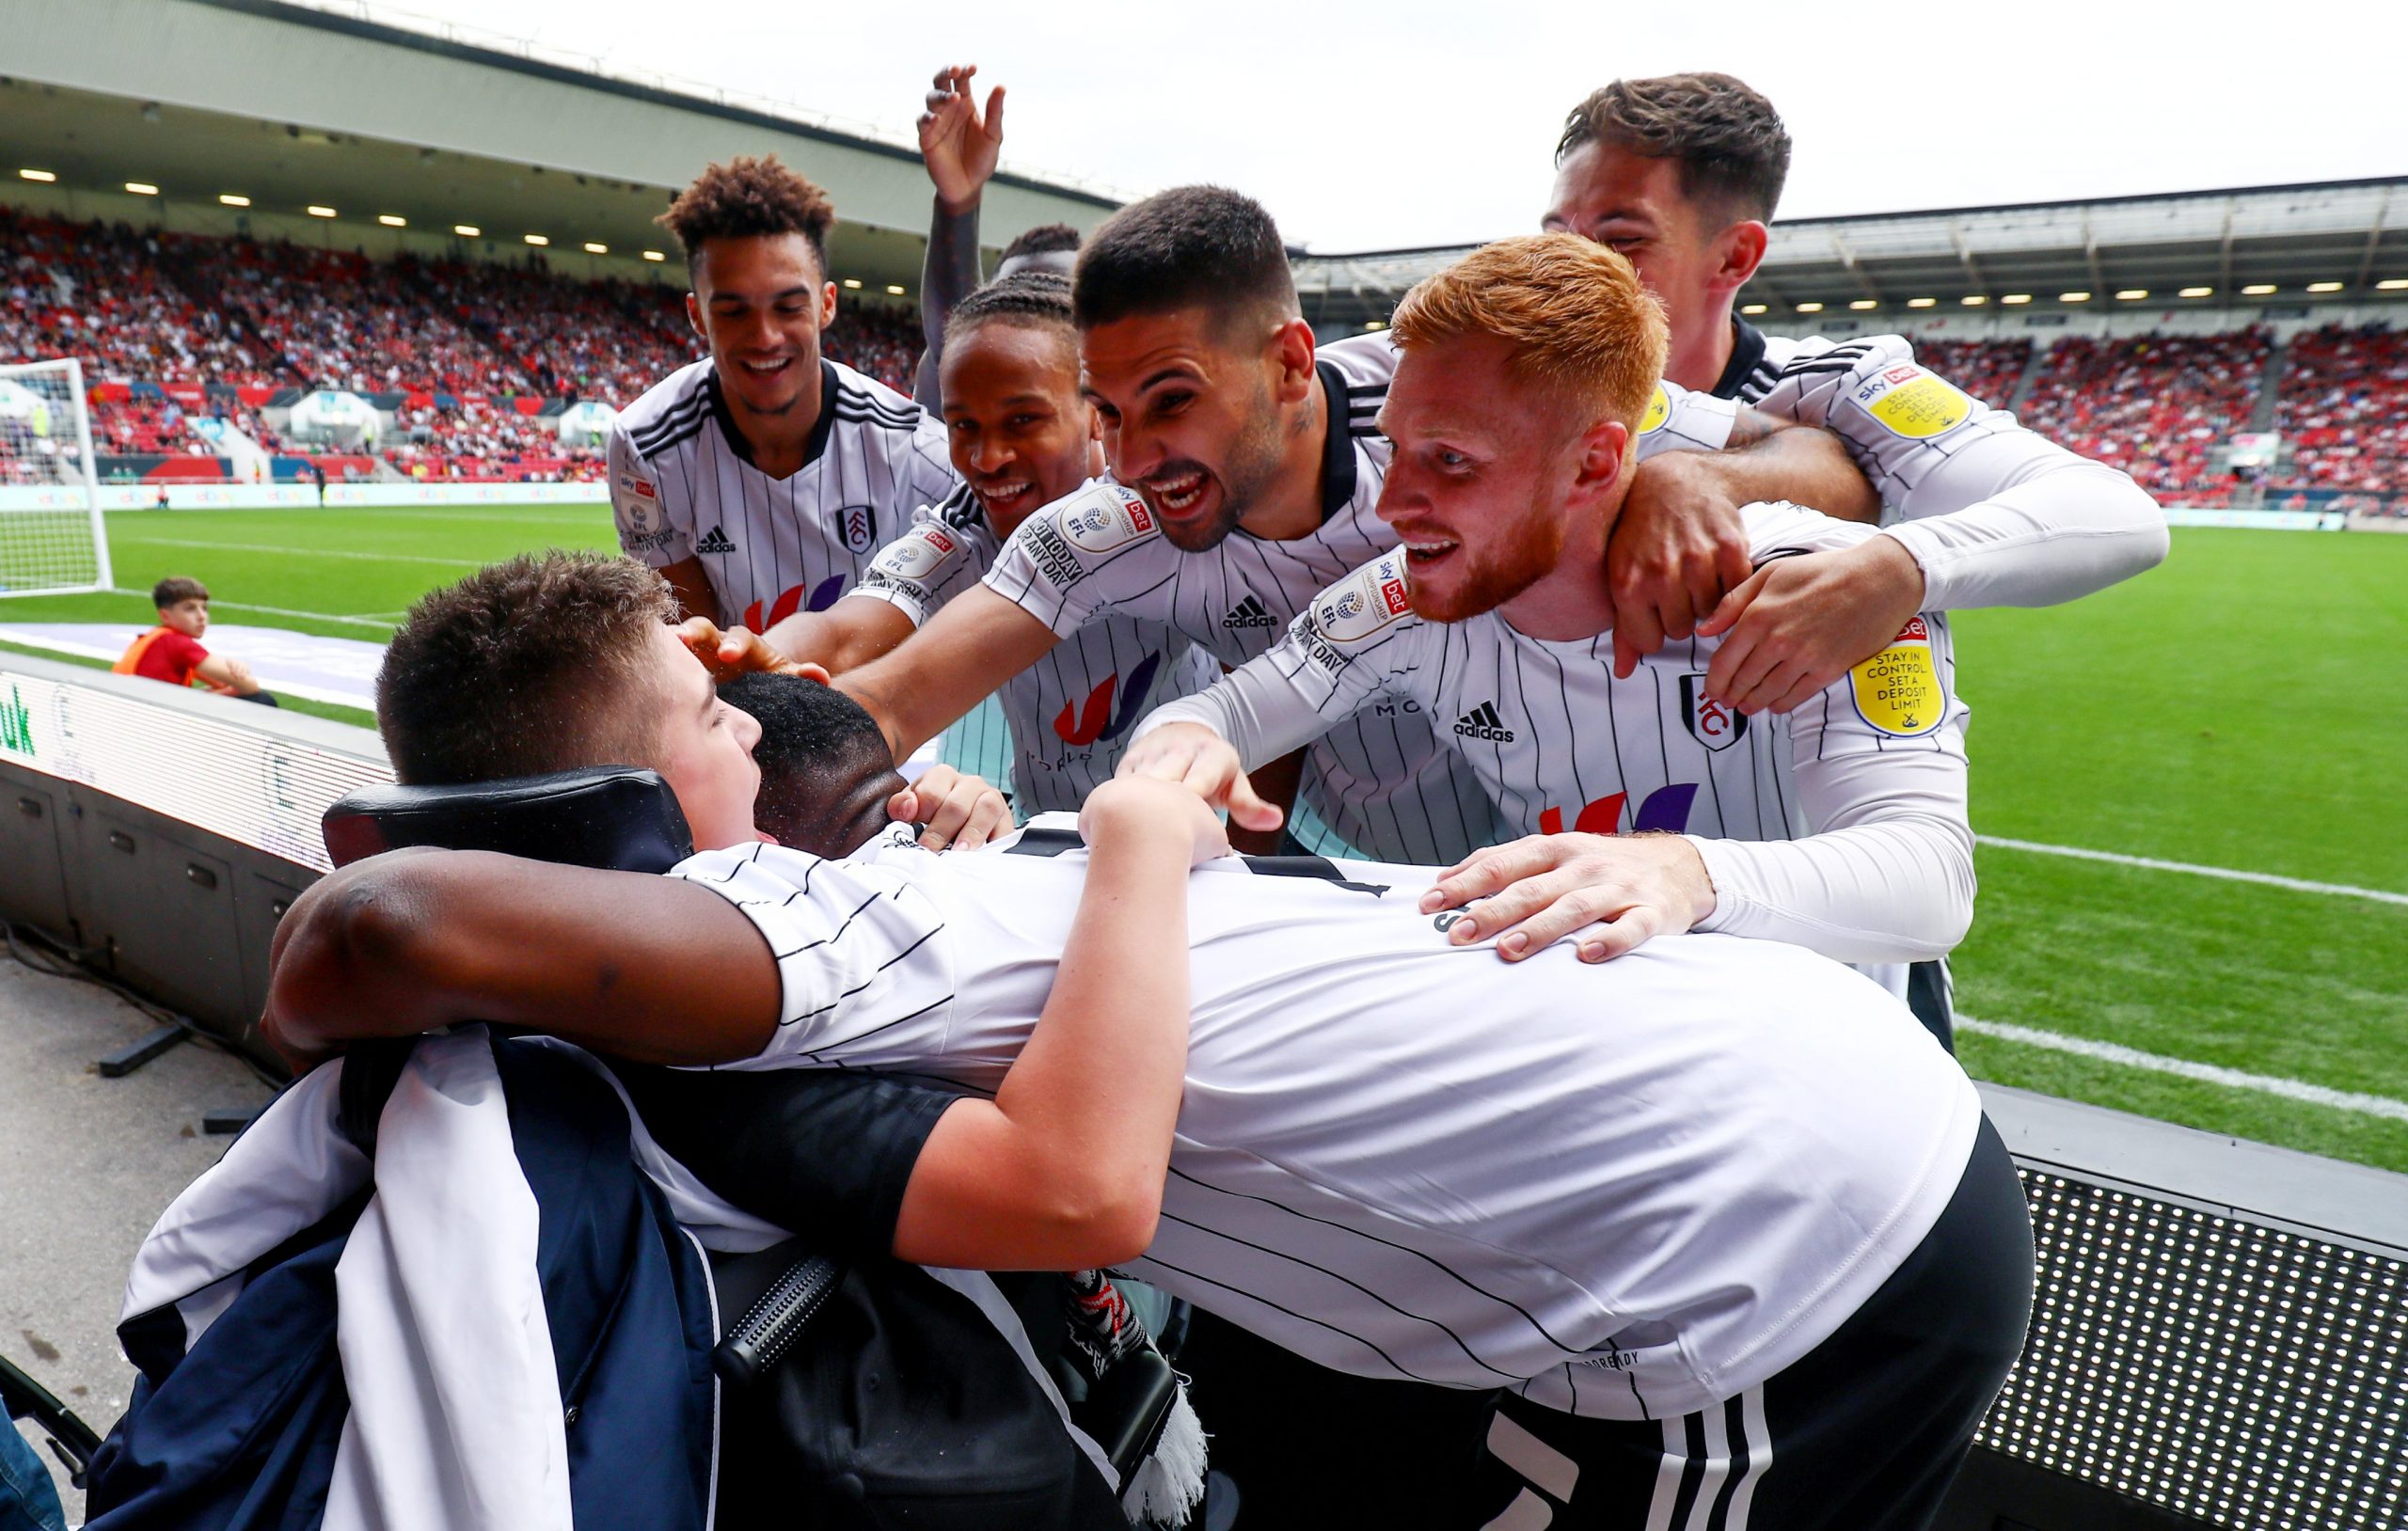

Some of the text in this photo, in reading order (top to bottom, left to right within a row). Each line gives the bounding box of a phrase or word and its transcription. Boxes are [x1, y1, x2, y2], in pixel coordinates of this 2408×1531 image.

[1859, 380, 1886, 401] sky
[621, 477, 634, 490] sky
[1101, 489, 1134, 536] CHAMPIONSHIP
[1115, 486, 1149, 529] sky bet
[848, 511, 866, 545] FFC
[1068, 517, 1085, 539] EFL
[696, 543, 737, 554] adidas
[927, 532, 949, 550] bet
[1029, 516, 1083, 577] NOT TODAY
[885, 560, 904, 572] EFL
[1017, 528, 1069, 587] OR ANY DAY
[1365, 569, 1388, 621] CHAMPIONSHIP
[1379, 560, 1406, 611] sky bet
[1222, 615, 1278, 628] adidas
[1322, 605, 1337, 629] EFL
[1313, 644, 1342, 671] DAY
[1876, 652, 1920, 665] STAY IN
[1889, 675, 1918, 687] SET A
[1877, 687, 1926, 701] DEPOSIT
[1892, 699, 1922, 710] LIMIT
[1453, 723, 1515, 743] adidas
